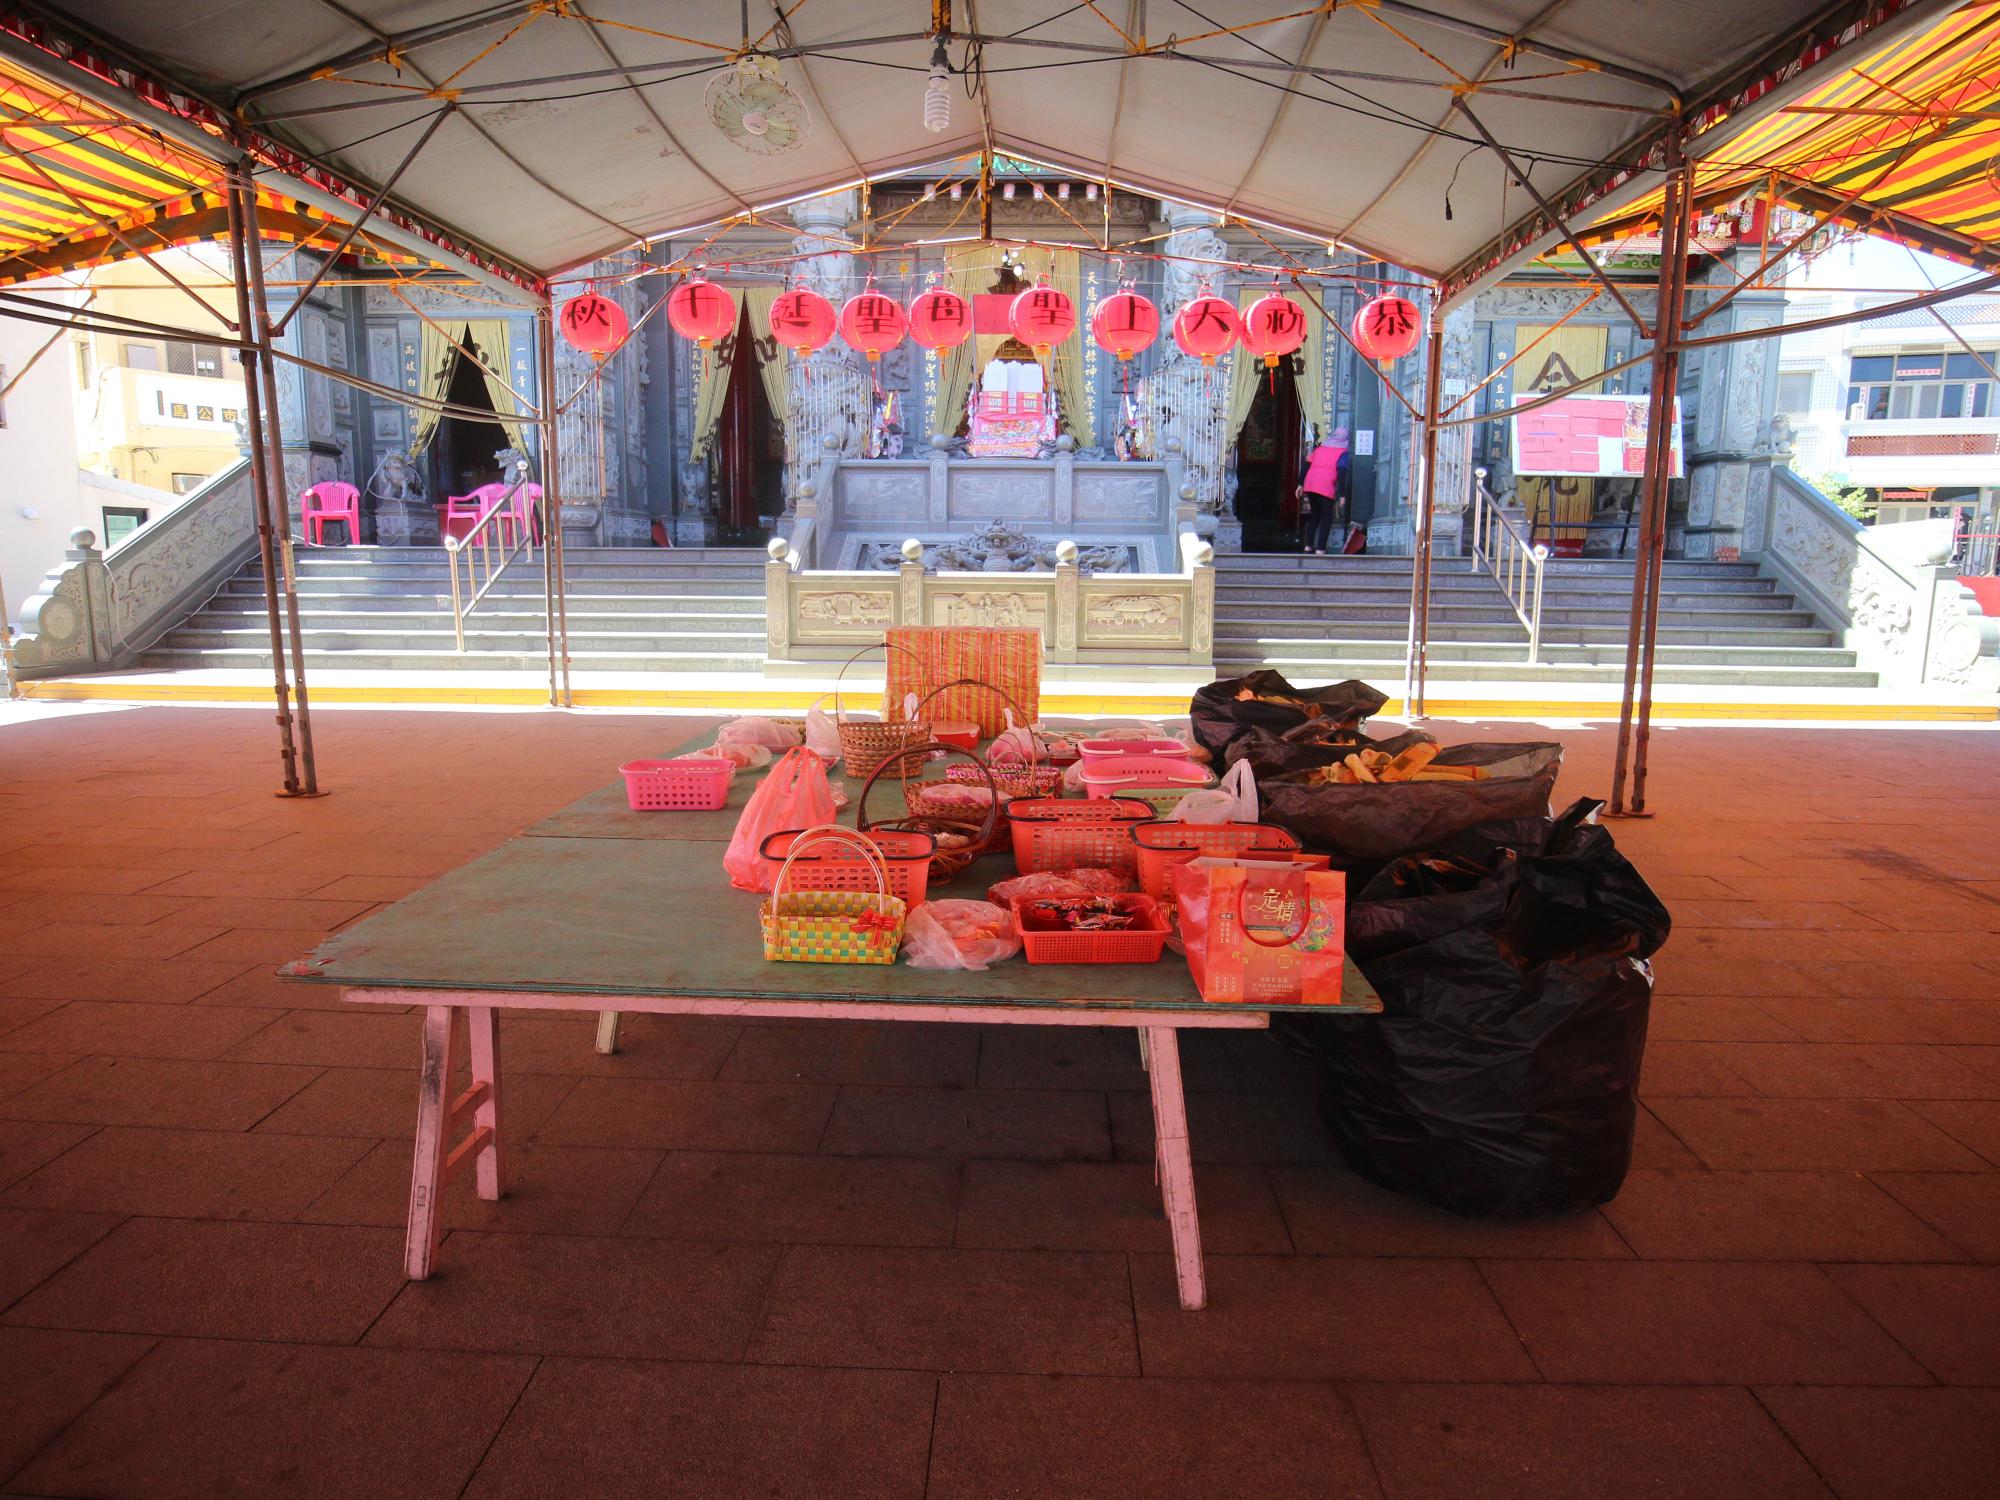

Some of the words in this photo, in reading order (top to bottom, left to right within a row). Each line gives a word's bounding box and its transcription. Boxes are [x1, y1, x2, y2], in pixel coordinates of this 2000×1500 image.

[566, 297, 612, 331] 秋
[682, 284, 718, 319] 千
[773, 296, 814, 331] 誕
[854, 295, 898, 336] 聖
[924, 295, 968, 328] 母
[1029, 291, 1072, 328] 聖
[1107, 295, 1153, 334] 上
[1372, 300, 1418, 336] 恭
[1265, 302, 1308, 339] 祝
[173, 403, 238, 423] 馬公市
[1248, 888, 1297, 922] 定情
